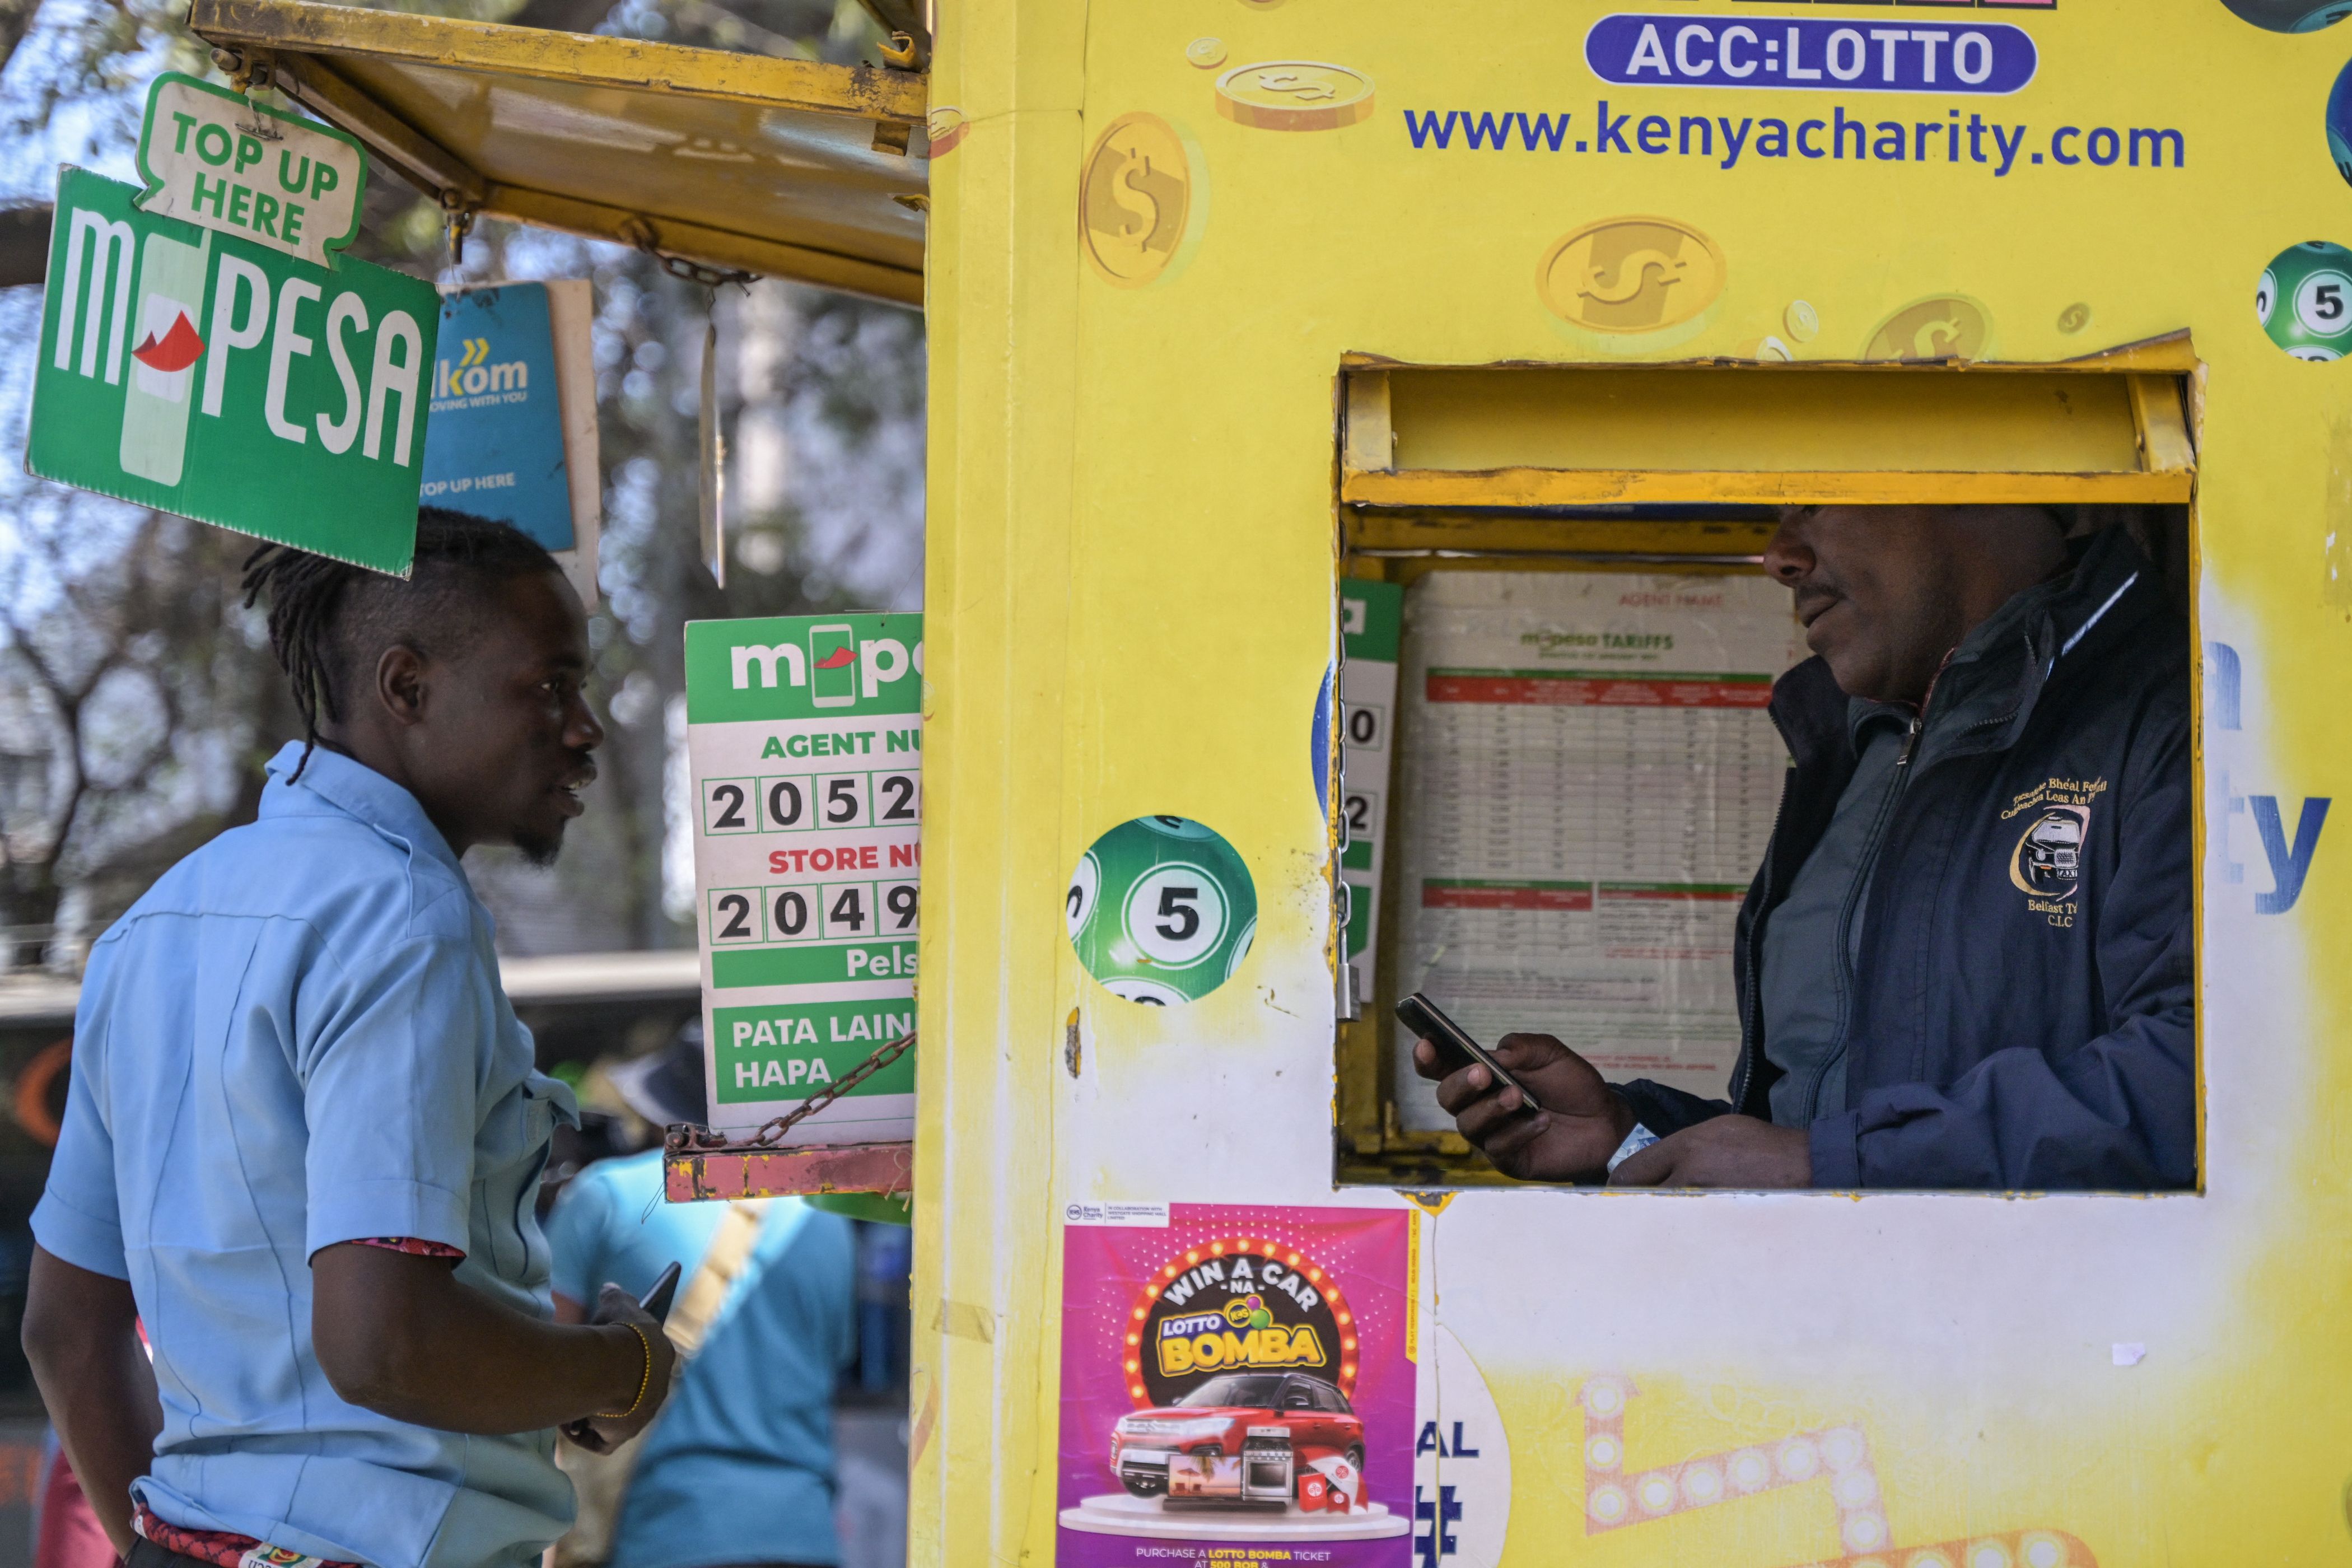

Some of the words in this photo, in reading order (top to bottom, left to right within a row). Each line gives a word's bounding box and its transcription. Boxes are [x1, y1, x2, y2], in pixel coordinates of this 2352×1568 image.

[1626, 24, 1992, 83] ACC:LOTTO
[1403, 101, 2185, 177] www.kenyacharity.com
[172, 112, 263, 175] TOP
[278, 151, 338, 200] UP
[191, 173, 305, 245] HERE
[470, 395, 500, 408] WITH
[502, 392, 528, 404] YOU
[450, 478, 472, 493] UP
[476, 473, 515, 488] HERE
[1602, 633, 1674, 650] TARIFFS
[731, 638, 922, 698] mp
[761, 731, 875, 759] AGENT
[769, 846, 878, 874] STORE
[1155, 887, 1199, 941] 5
[2028, 899, 2064, 914] Belfast
[733, 1018, 818, 1047] PATA
[735, 1058, 831, 1088] HAPA
[1164, 1261, 1224, 1306] WIN
[1232, 1257, 1253, 1278] A
[1262, 1263, 1318, 1313] CAR
[1163, 1315, 1221, 1337] LOTTO
[1160, 1328, 1322, 1373] BOMBA
[1136, 1548, 1196, 1558] PURCHASE
[1198, 1550, 1206, 1558] A
[1208, 1550, 1245, 1559] LOTTO
[1248, 1550, 1291, 1560] BOMBA
[1294, 1551, 1331, 1561] TICKET
